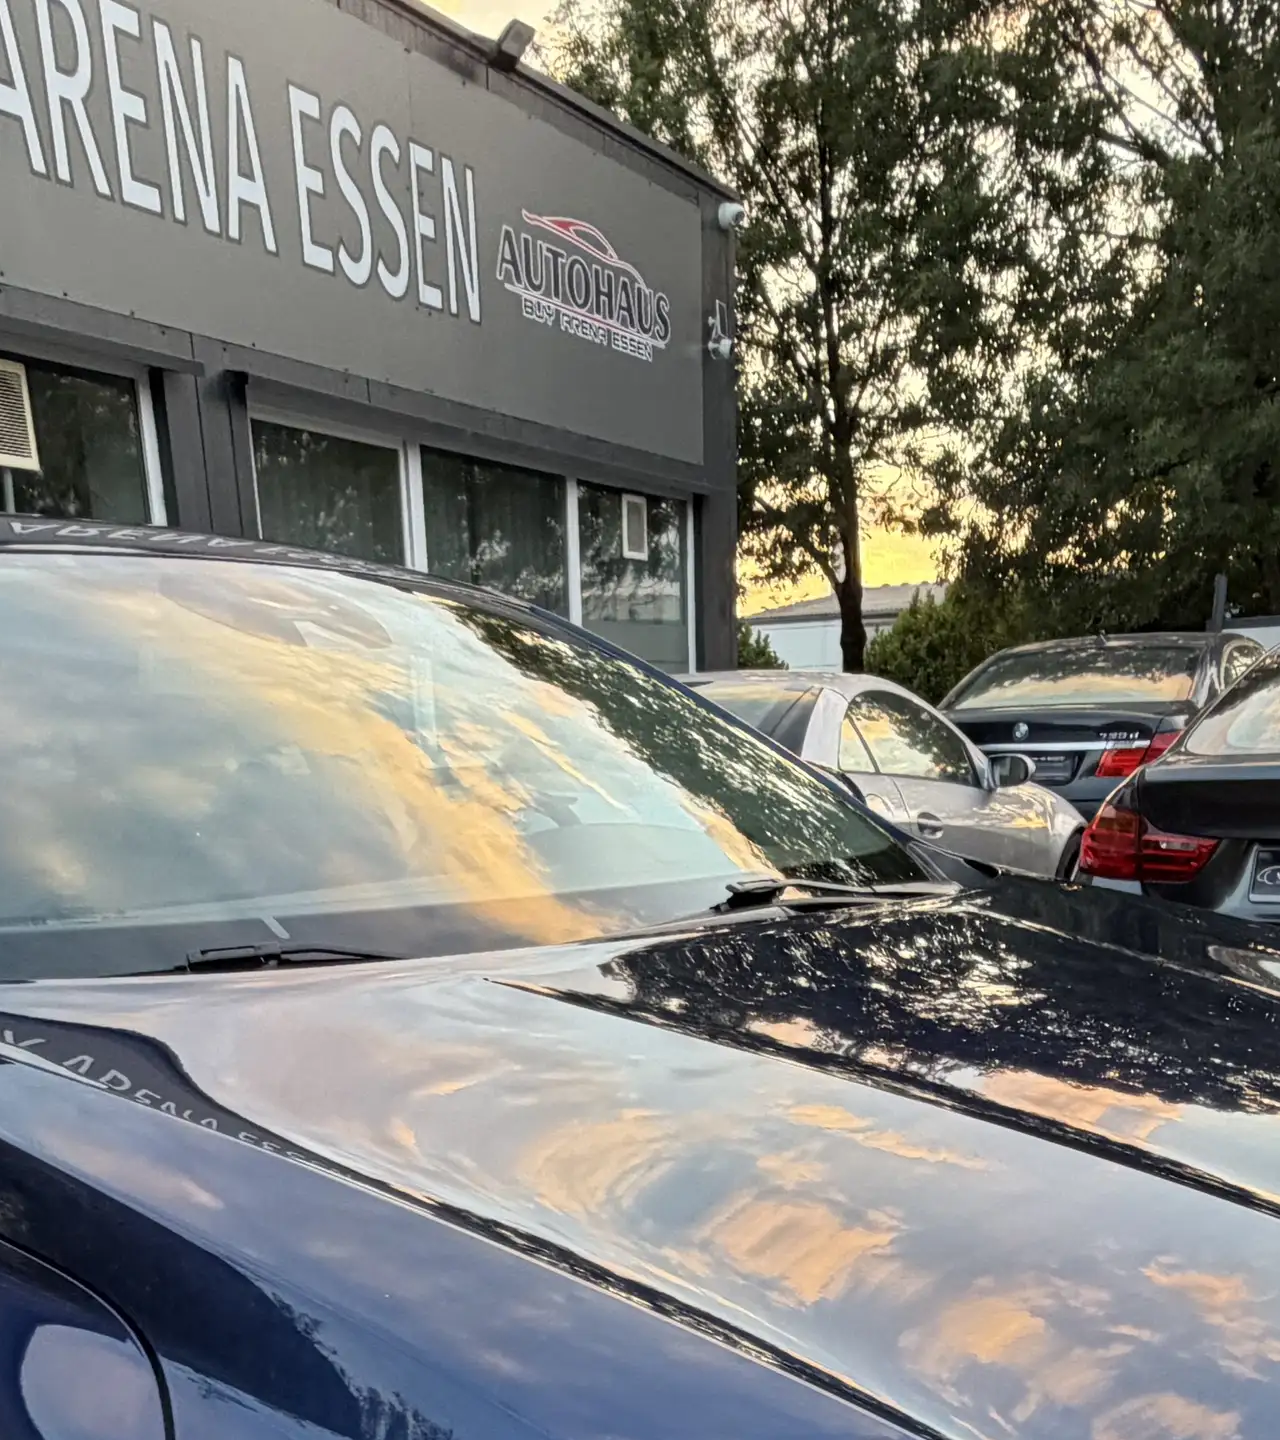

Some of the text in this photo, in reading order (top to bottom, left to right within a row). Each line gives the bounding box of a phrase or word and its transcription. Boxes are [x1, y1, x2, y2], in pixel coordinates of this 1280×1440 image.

[286, 82, 483, 324] ESSEN
[496, 224, 672, 345] AUTOHAUS
[521, 296, 654, 362] BUY ARENA ESSEN
